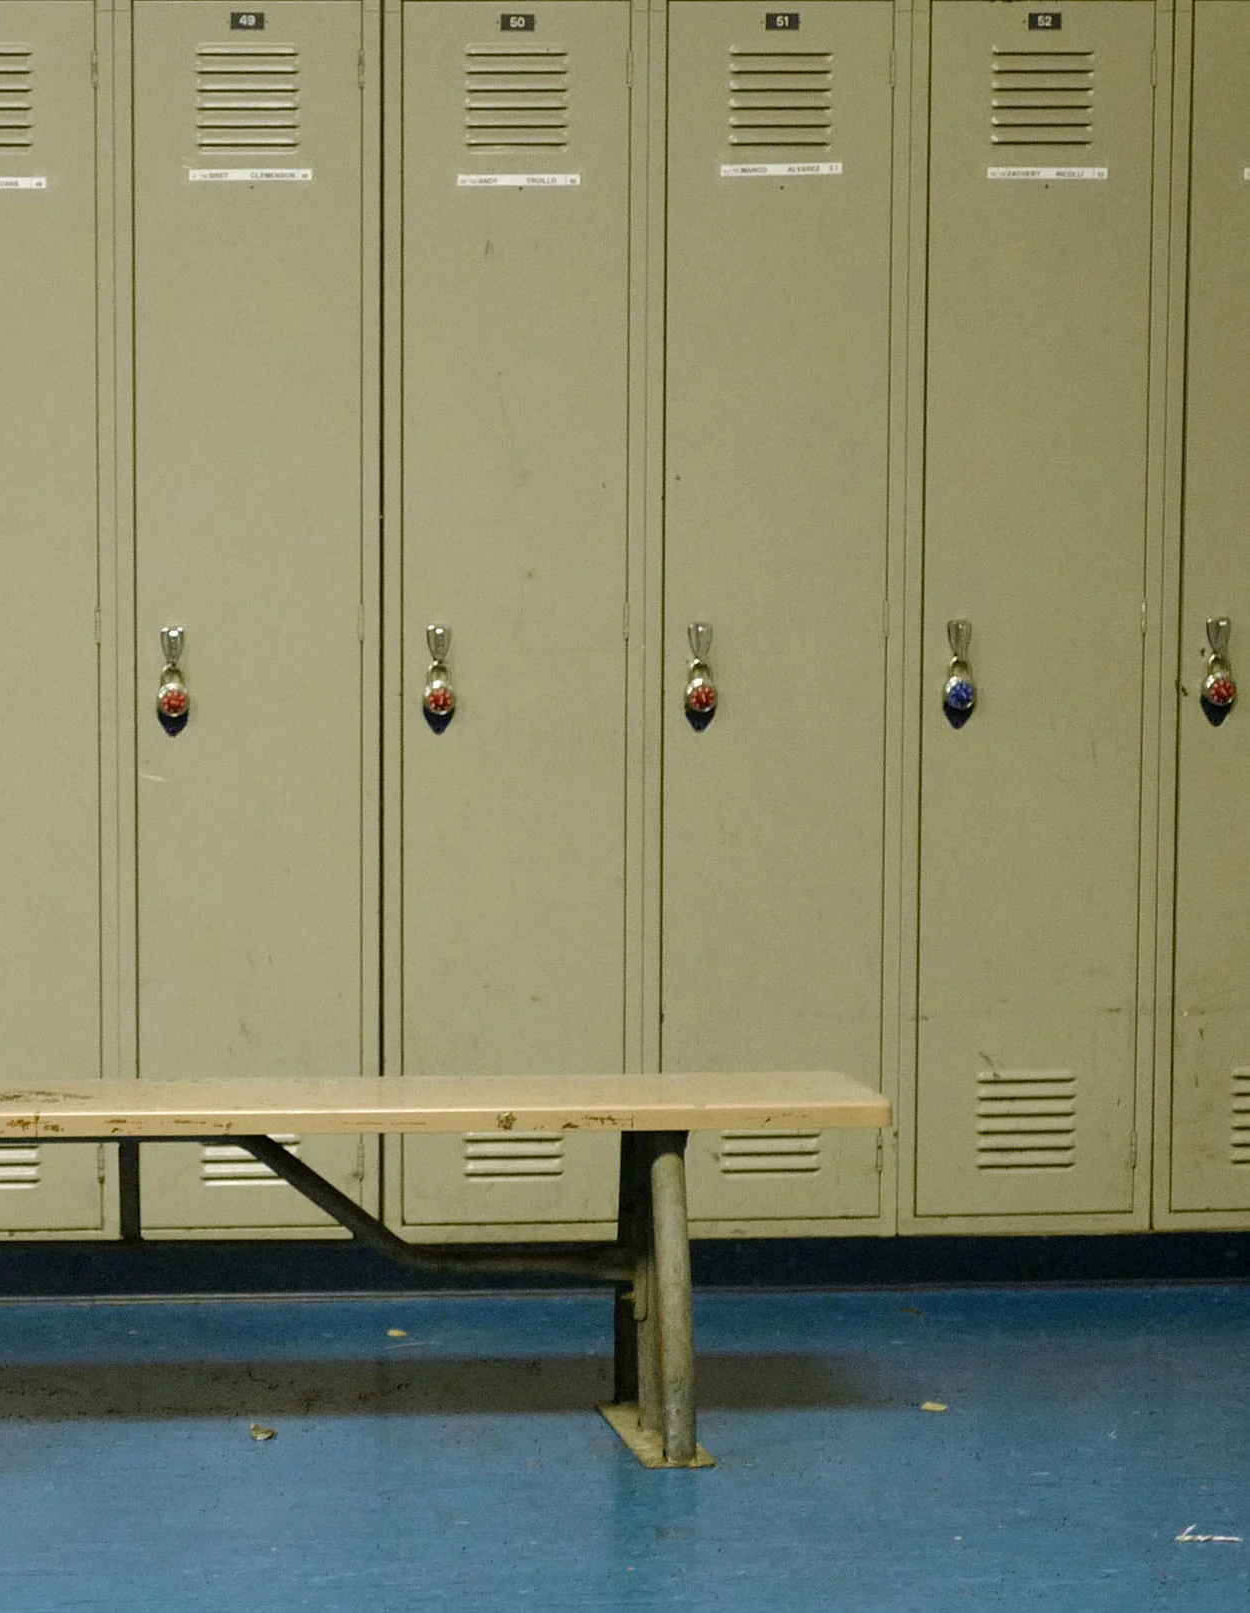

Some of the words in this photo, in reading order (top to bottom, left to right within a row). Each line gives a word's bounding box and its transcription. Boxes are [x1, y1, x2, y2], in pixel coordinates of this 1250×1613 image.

[238, 15, 255, 25] 49
[510, 17, 525, 27] 50
[777, 16, 789, 26] 51
[1037, 16, 1052, 26] 52
